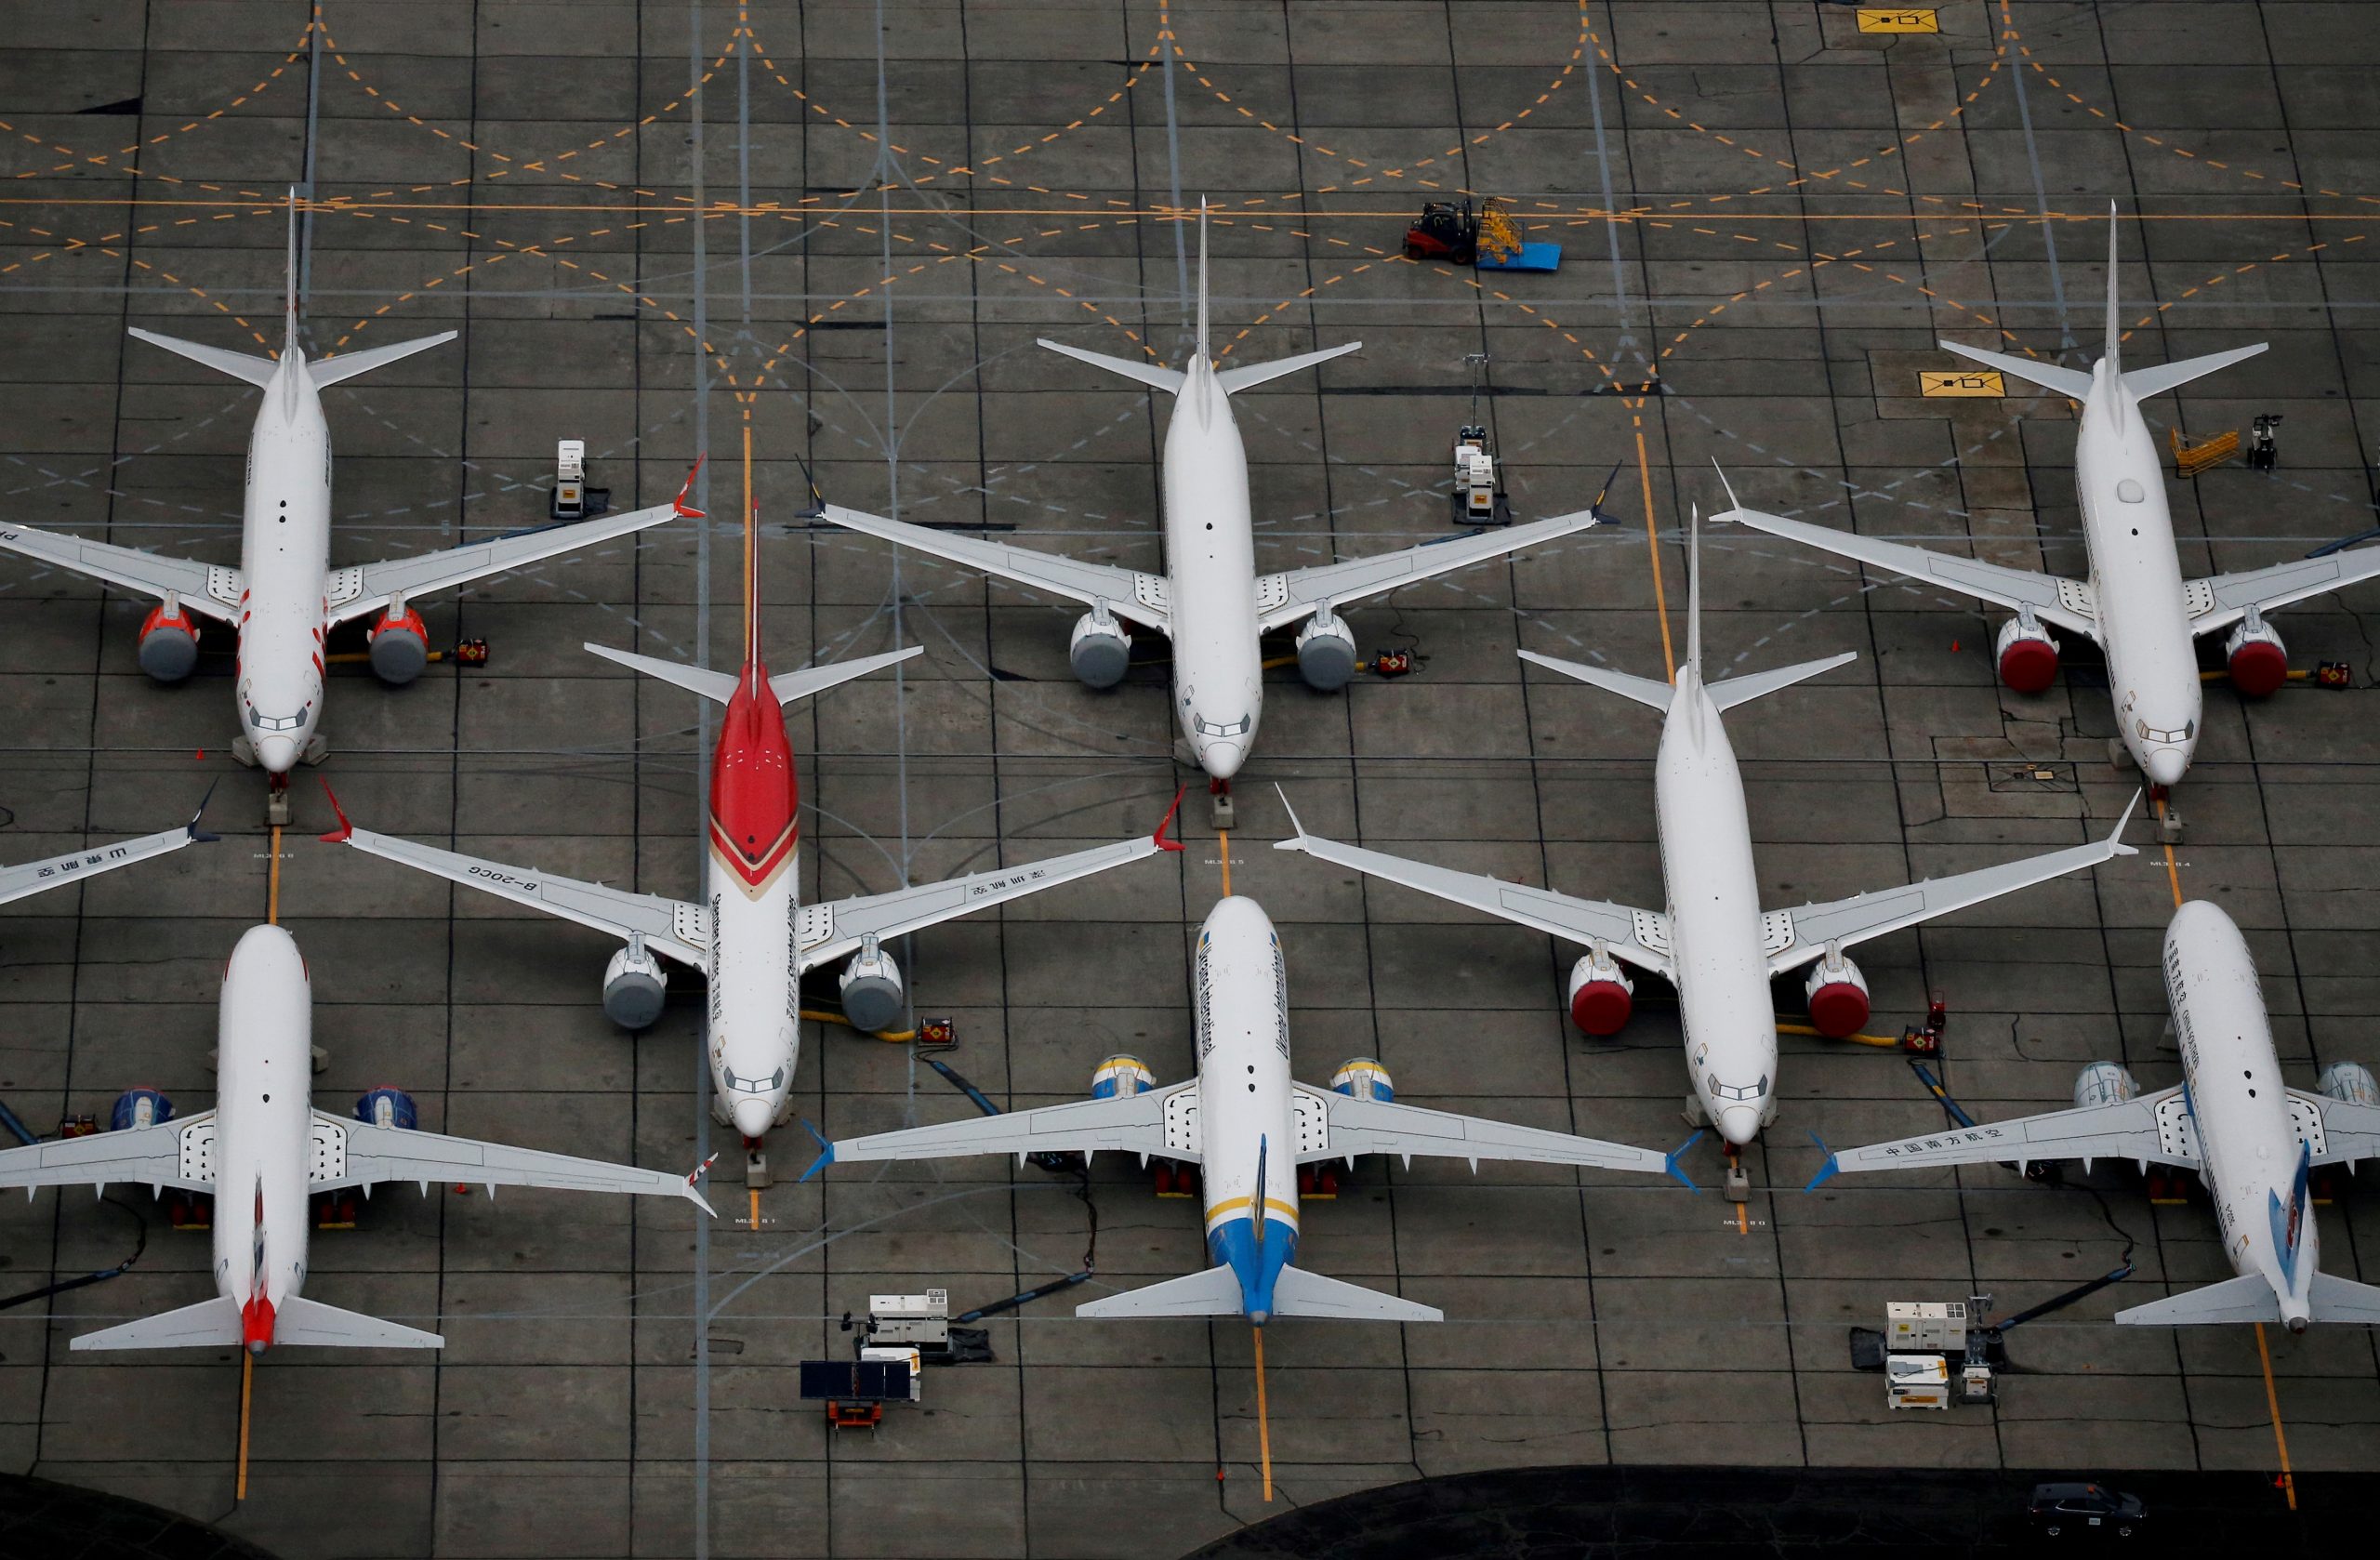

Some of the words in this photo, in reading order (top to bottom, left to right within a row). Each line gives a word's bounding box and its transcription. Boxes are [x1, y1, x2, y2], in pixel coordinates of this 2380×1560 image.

[469, 866, 537, 891] B-20CG
[1198, 942, 1212, 990] Ukraine
[1200, 985, 1216, 1059] International
[1885, 1130, 2003, 1157] 中国南方航空
